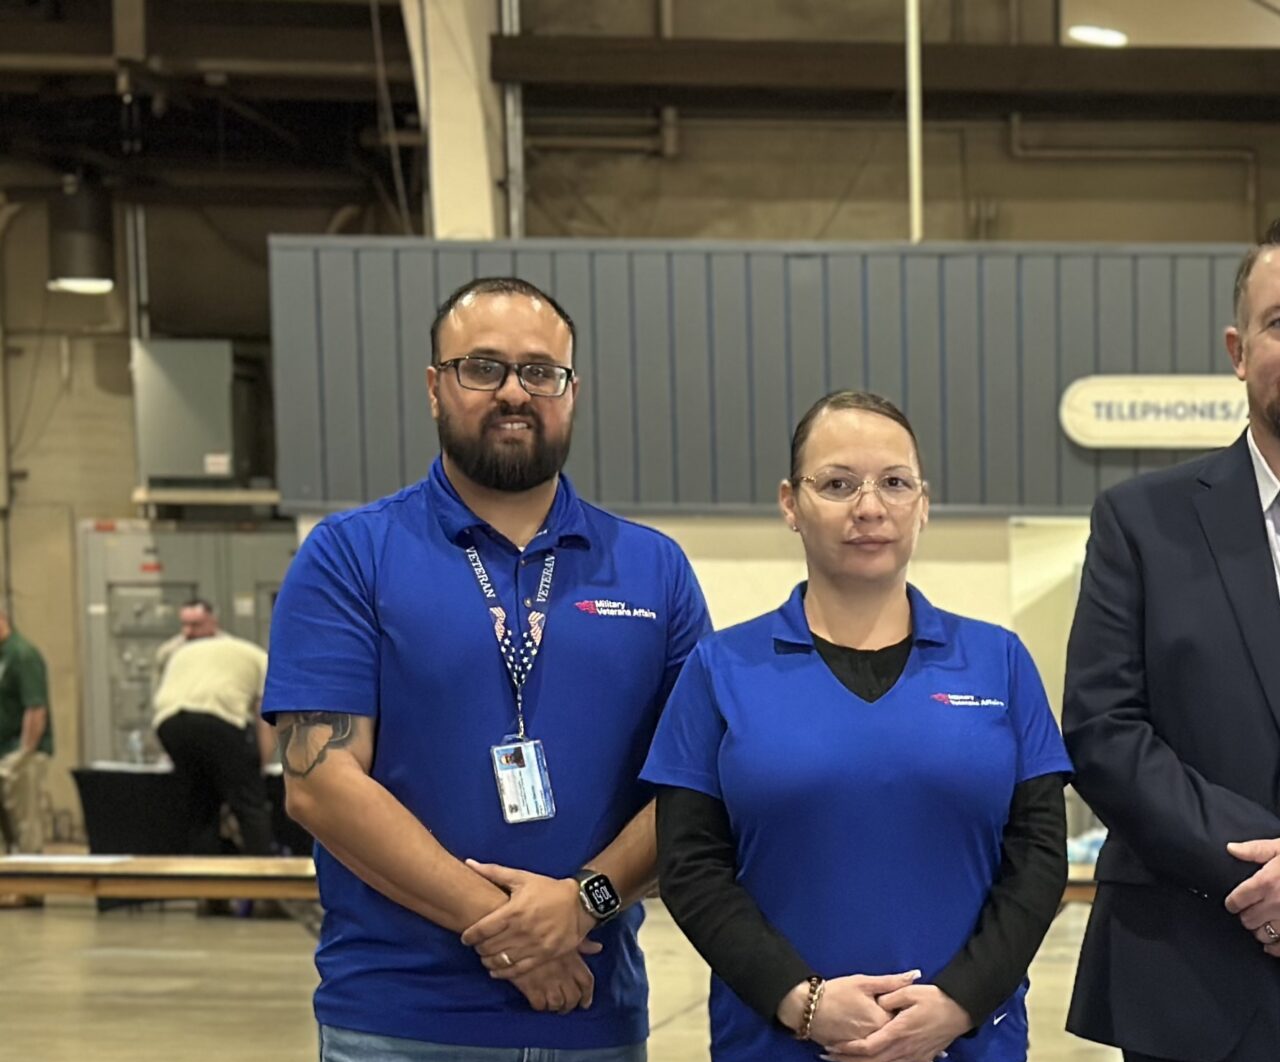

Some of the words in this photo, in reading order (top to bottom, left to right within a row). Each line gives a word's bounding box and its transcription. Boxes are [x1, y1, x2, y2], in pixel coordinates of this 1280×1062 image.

[1093, 400, 1250, 421] TELEPHONES/
[465, 546, 496, 599] VETERAN
[536, 555, 555, 603] VETERAN
[594, 599, 626, 610] Military
